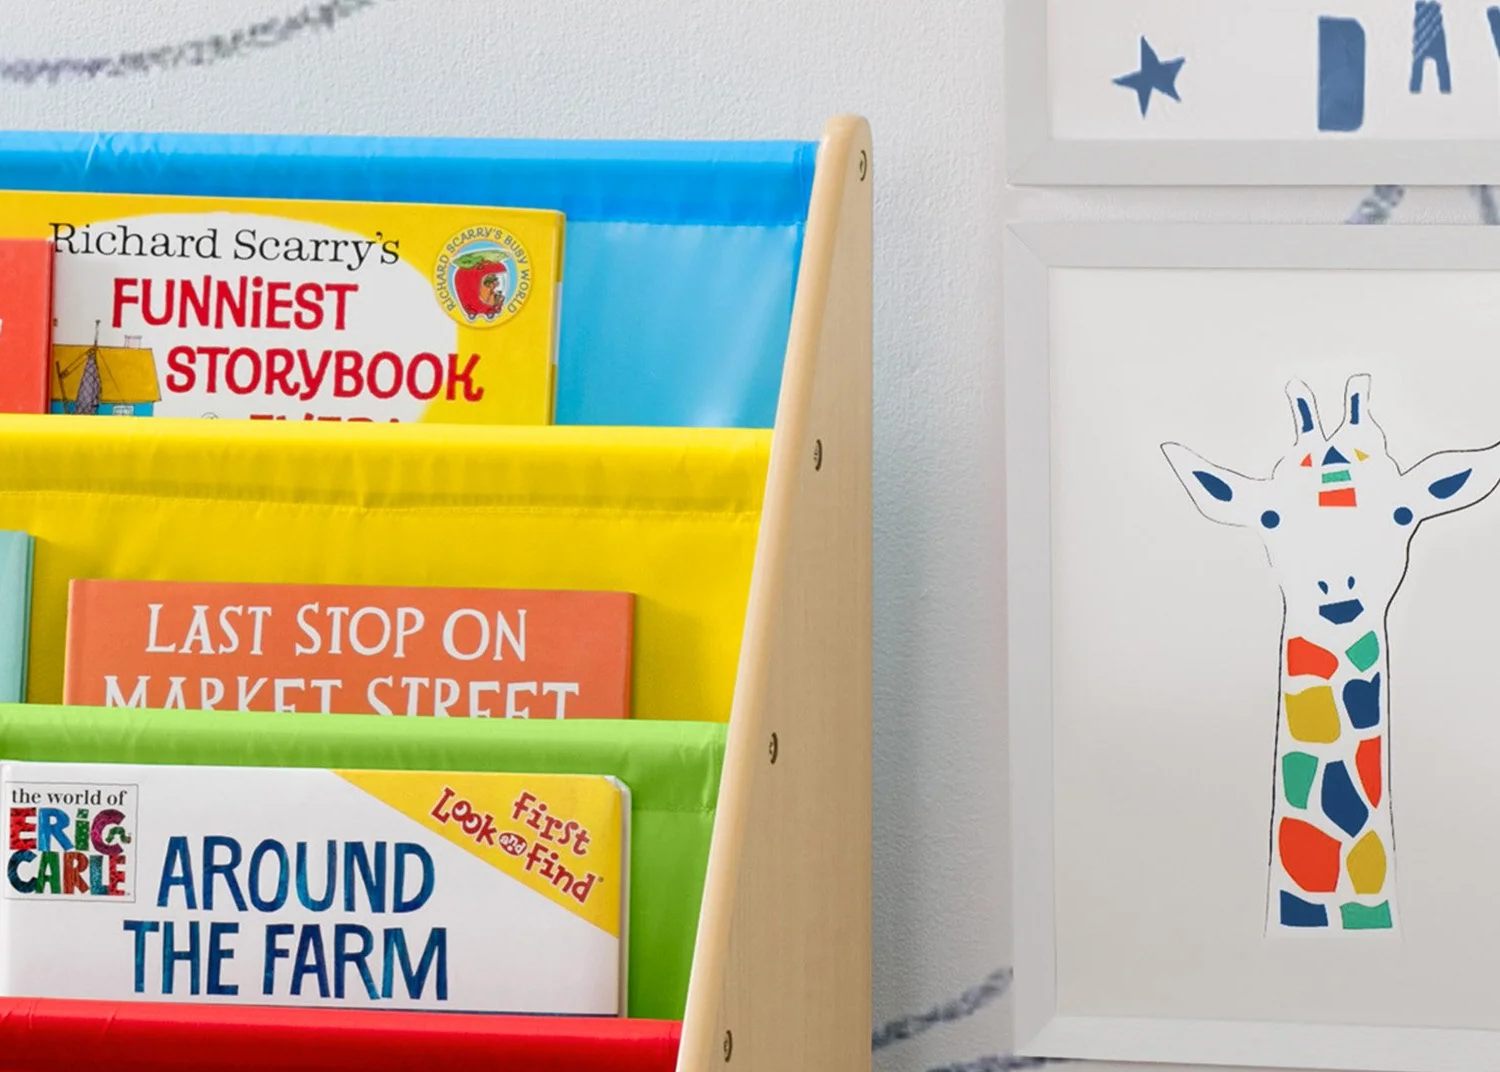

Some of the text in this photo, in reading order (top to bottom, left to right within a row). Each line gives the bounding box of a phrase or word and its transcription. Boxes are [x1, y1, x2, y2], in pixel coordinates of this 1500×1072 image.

[50, 222, 400, 272] Richard Scarry's
[436, 227, 530, 313] RICHARD SCARRY'S BUSY WORLD
[166, 346, 483, 402] STORYBOOK
[145, 602, 527, 661] LAST STOP ON
[104, 675, 579, 719] MARKET STREET
[12, 788, 127, 806] the world of
[7, 850, 126, 896] CARLE
[431, 787, 595, 903] Look and Find
[156, 835, 435, 913] AROUND
[123, 920, 448, 1000] THE FARM
